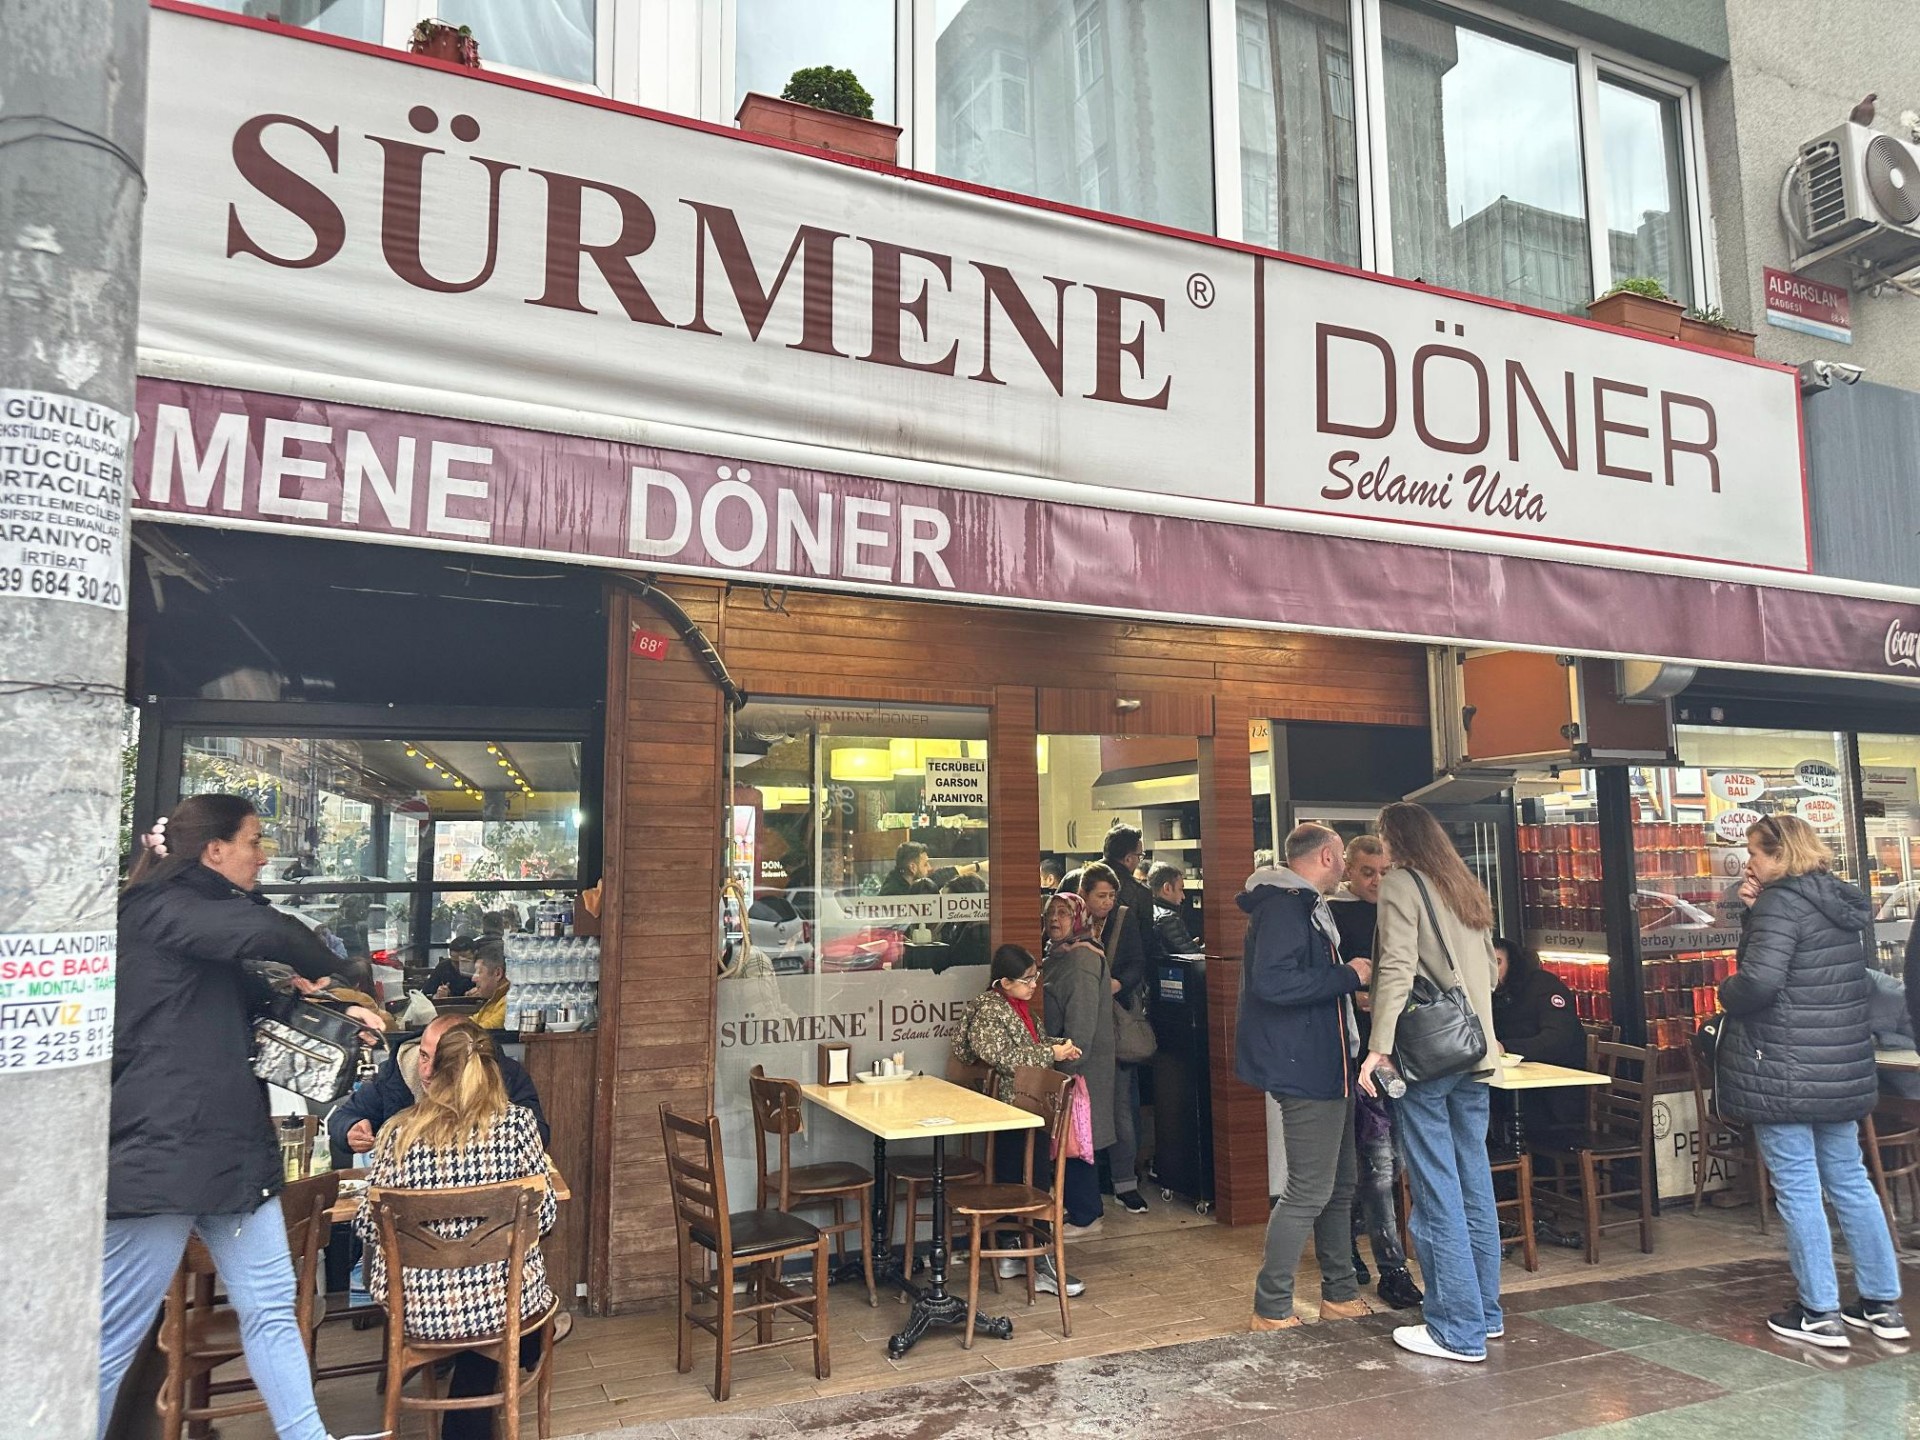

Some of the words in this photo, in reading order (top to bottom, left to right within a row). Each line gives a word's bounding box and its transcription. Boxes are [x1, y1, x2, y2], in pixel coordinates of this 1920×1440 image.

[227, 104, 1173, 411] SÜRMENE
[1315, 319, 1722, 494] DÖNER
[1769, 276, 1838, 308] ALPARSLAN
[6, 396, 117, 438] GÜNLÜK
[0, 443, 123, 487] TÜCÜLER
[0, 469, 121, 508] RTACILAR
[131, 403, 493, 539] MENE
[627, 464, 956, 588] DÖNER
[1320, 450, 1453, 510] Selami
[1463, 464, 1548, 523] Usta
[22, 547, 88, 571] İRTİBAT
[31, 568, 70, 596] 684
[77, 573, 99, 601] 30
[103, 580, 121, 606] 20
[1884, 618, 1920, 670] Coca-
[804, 705, 876, 724] SÜRMENE
[928, 760, 985, 772] TECRÜBELİ
[1800, 765, 1836, 778] ERZURUM
[935, 777, 978, 788] GARSON
[1724, 775, 1756, 786] ANZER
[930, 793, 984, 803] ARANIYOR
[1727, 786, 1749, 797] BALI
[843, 901, 932, 919] SÜRMENE
[1544, 934, 1584, 948] erbay
[1641, 934, 1676, 949] erbay
[1706, 930, 1741, 946] peyni
[1, 960, 54, 979] SAC
[62, 956, 110, 976] BACA
[28, 979, 85, 997] MONTAJ
[88, 1007, 107, 1022] LTD
[36, 1030, 81, 1047] 425
[720, 1013, 867, 1048] SÜRMENE
[891, 1028, 930, 1042] Selami
[36, 1047, 79, 1066] 243
